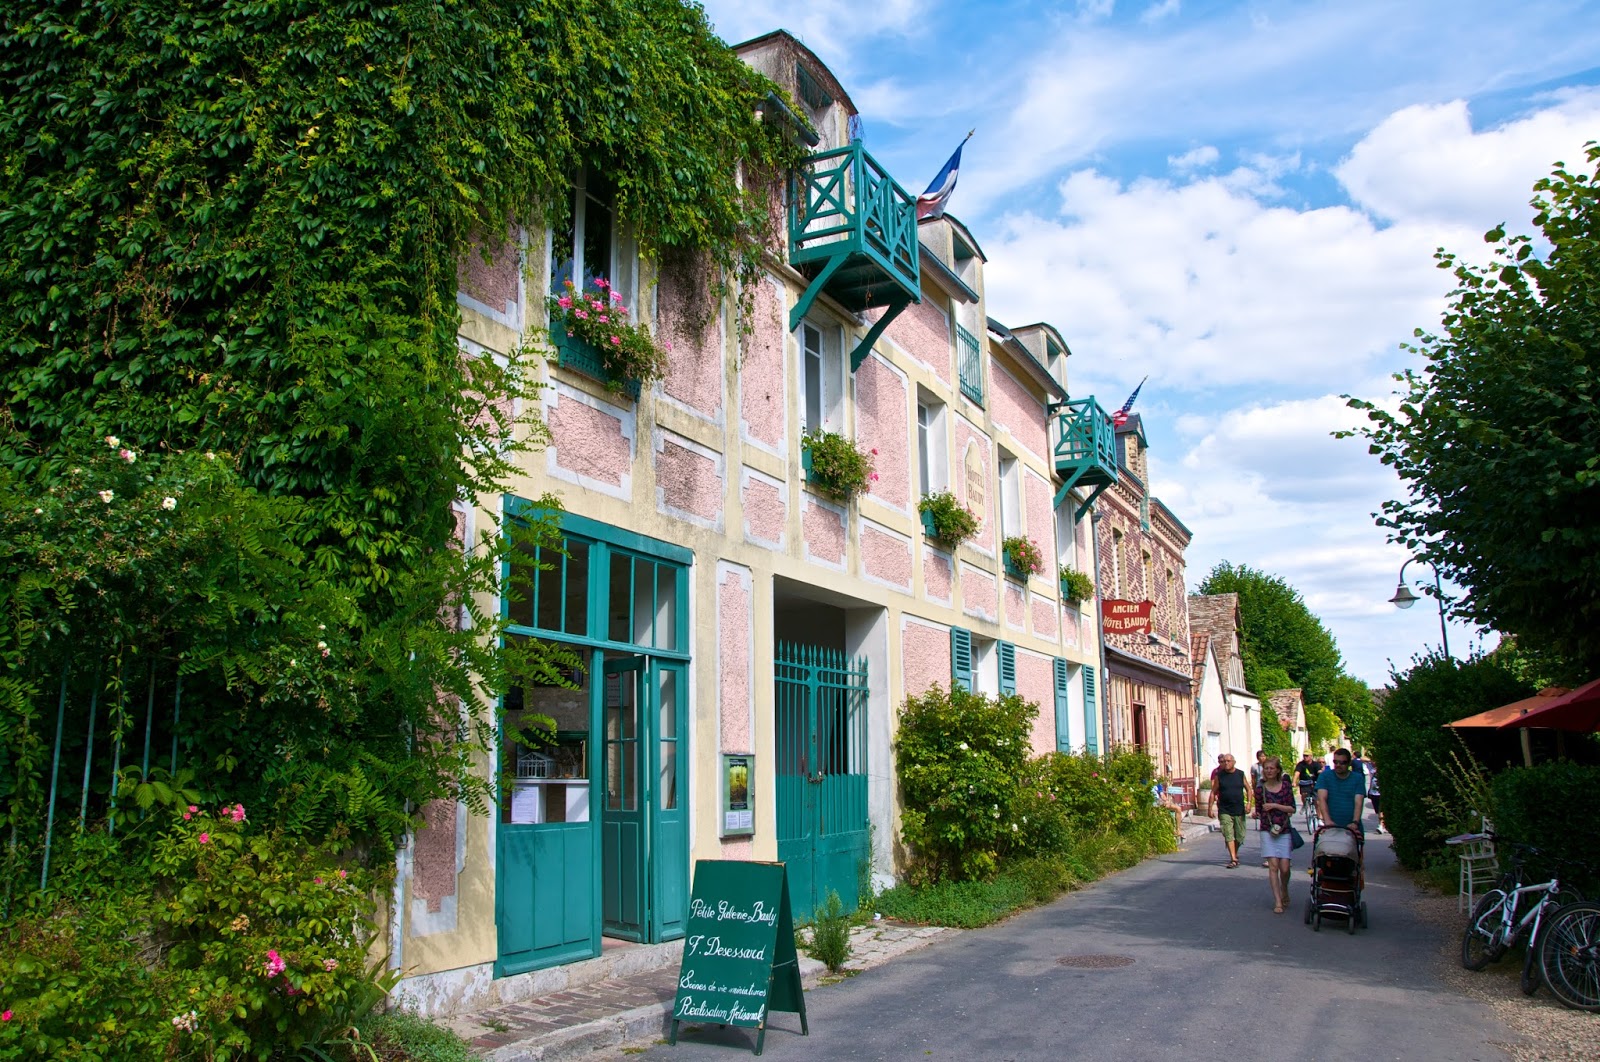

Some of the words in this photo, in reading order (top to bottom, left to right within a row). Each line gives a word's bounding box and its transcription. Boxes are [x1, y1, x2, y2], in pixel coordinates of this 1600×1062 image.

[1112, 604, 1140, 614] ANCIEN
[1124, 617, 1150, 629] BAUDY
[690, 898, 716, 920] Petite
[717, 899, 748, 921] Galerie
[708, 981, 717, 992] de
[718, 984, 728, 993] vie
